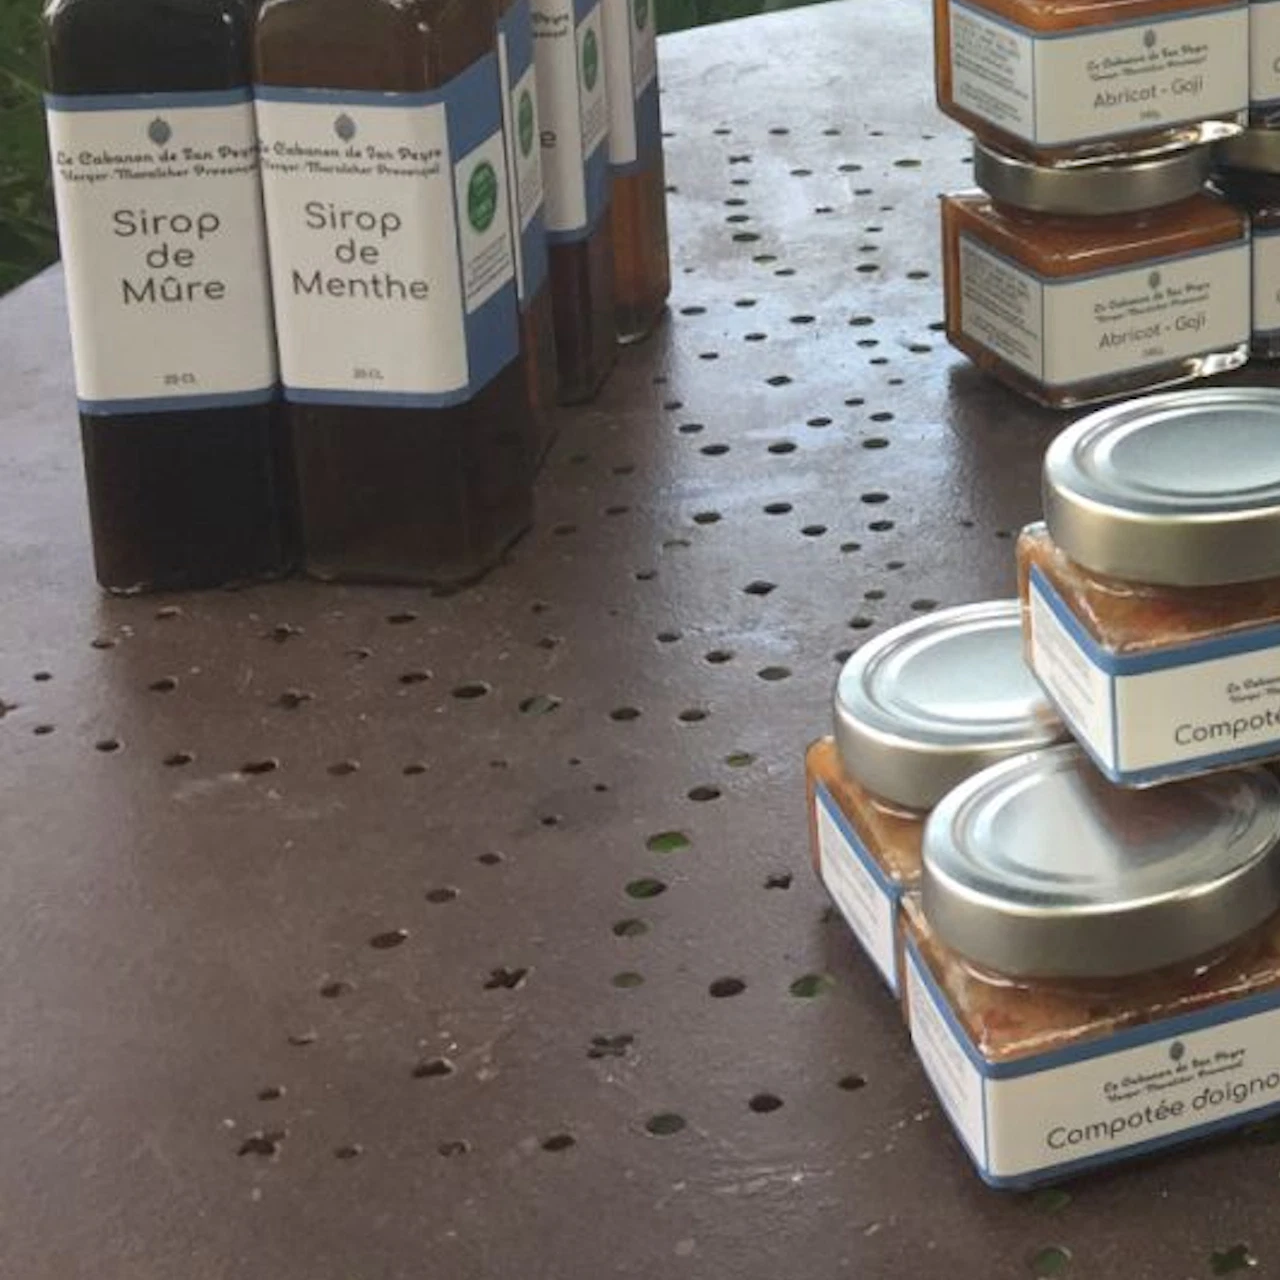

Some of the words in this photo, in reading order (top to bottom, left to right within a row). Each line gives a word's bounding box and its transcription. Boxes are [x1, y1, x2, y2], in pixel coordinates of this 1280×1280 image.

[1094, 85, 1157, 109] Abricot
[1171, 75, 1203, 96] Goji
[113, 209, 220, 240] Sirop
[304, 201, 402, 237] Sirop
[146, 242, 195, 269] de
[335, 239, 380, 264] de
[122, 276, 226, 304] Mûre
[292, 270, 430, 300] Menthe
[1099, 324, 1161, 349] Abricot
[1047, 1098, 1185, 1150] Compotée
